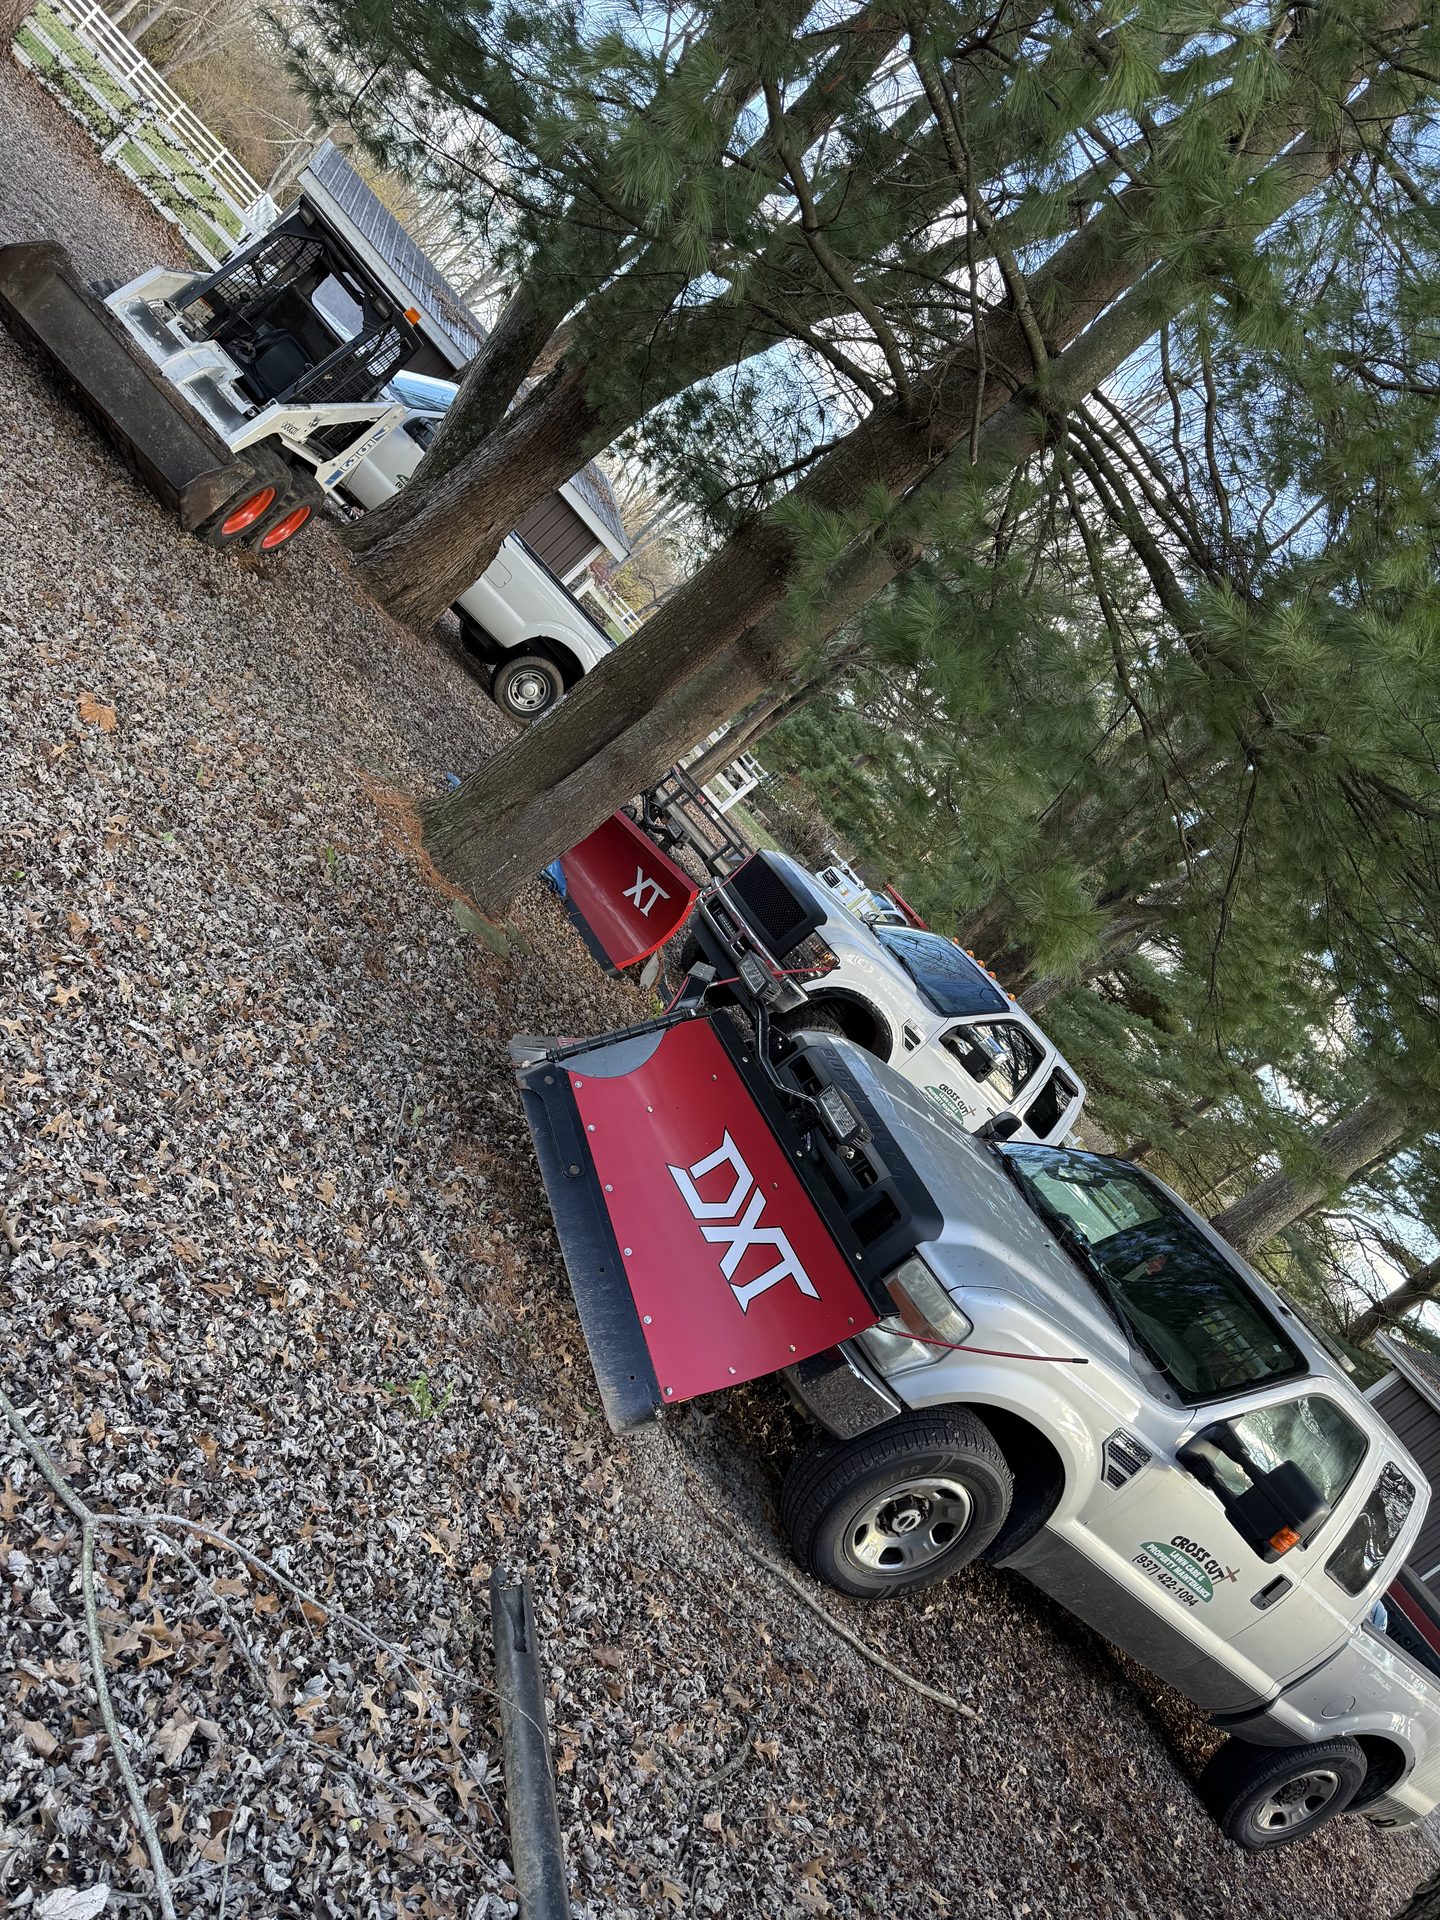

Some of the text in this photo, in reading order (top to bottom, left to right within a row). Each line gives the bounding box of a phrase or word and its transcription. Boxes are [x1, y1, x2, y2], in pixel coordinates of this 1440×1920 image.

[939, 1083, 968, 1116] CROSS CUT
[666, 1125, 823, 1316] DXT
[1132, 1553, 1199, 1606] (937) 422-1094
[1146, 1543, 1211, 1599] PROPERTY MAINTENANCE
[1170, 1535, 1225, 1580] CROSS CUT
[1170, 1550, 1189, 1567] LAWN
[1185, 1564, 1201, 1579] CARE
